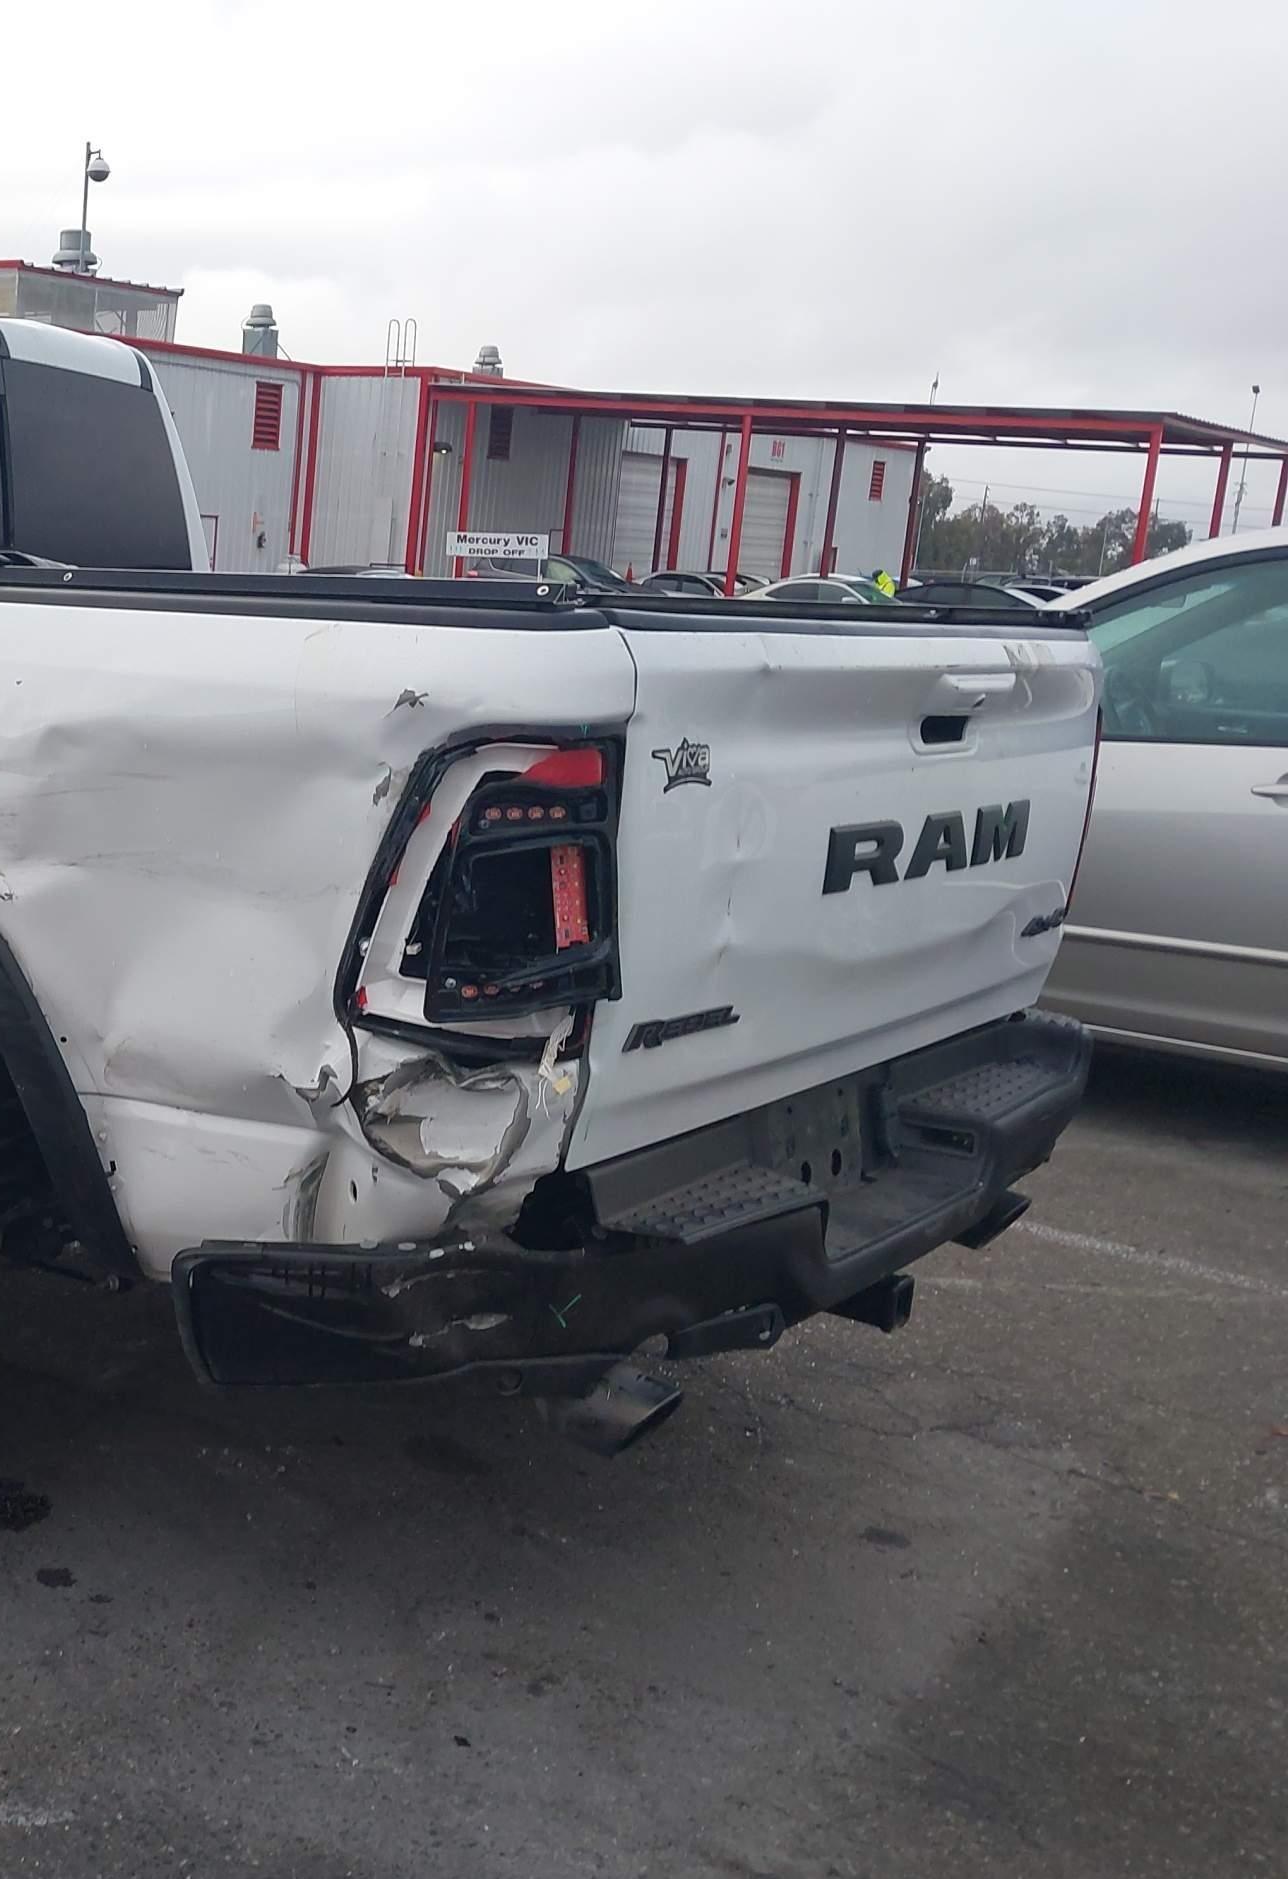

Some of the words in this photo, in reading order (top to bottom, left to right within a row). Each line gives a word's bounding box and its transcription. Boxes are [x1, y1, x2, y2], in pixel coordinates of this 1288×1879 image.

[456, 534, 511, 547] Mercury
[516, 535, 539, 546] VIC
[468, 547, 499, 556] DROP
[503, 548, 526, 557] OFF
[822, 799, 1031, 896] RAM
[621, 1005, 741, 1053] REBEL
